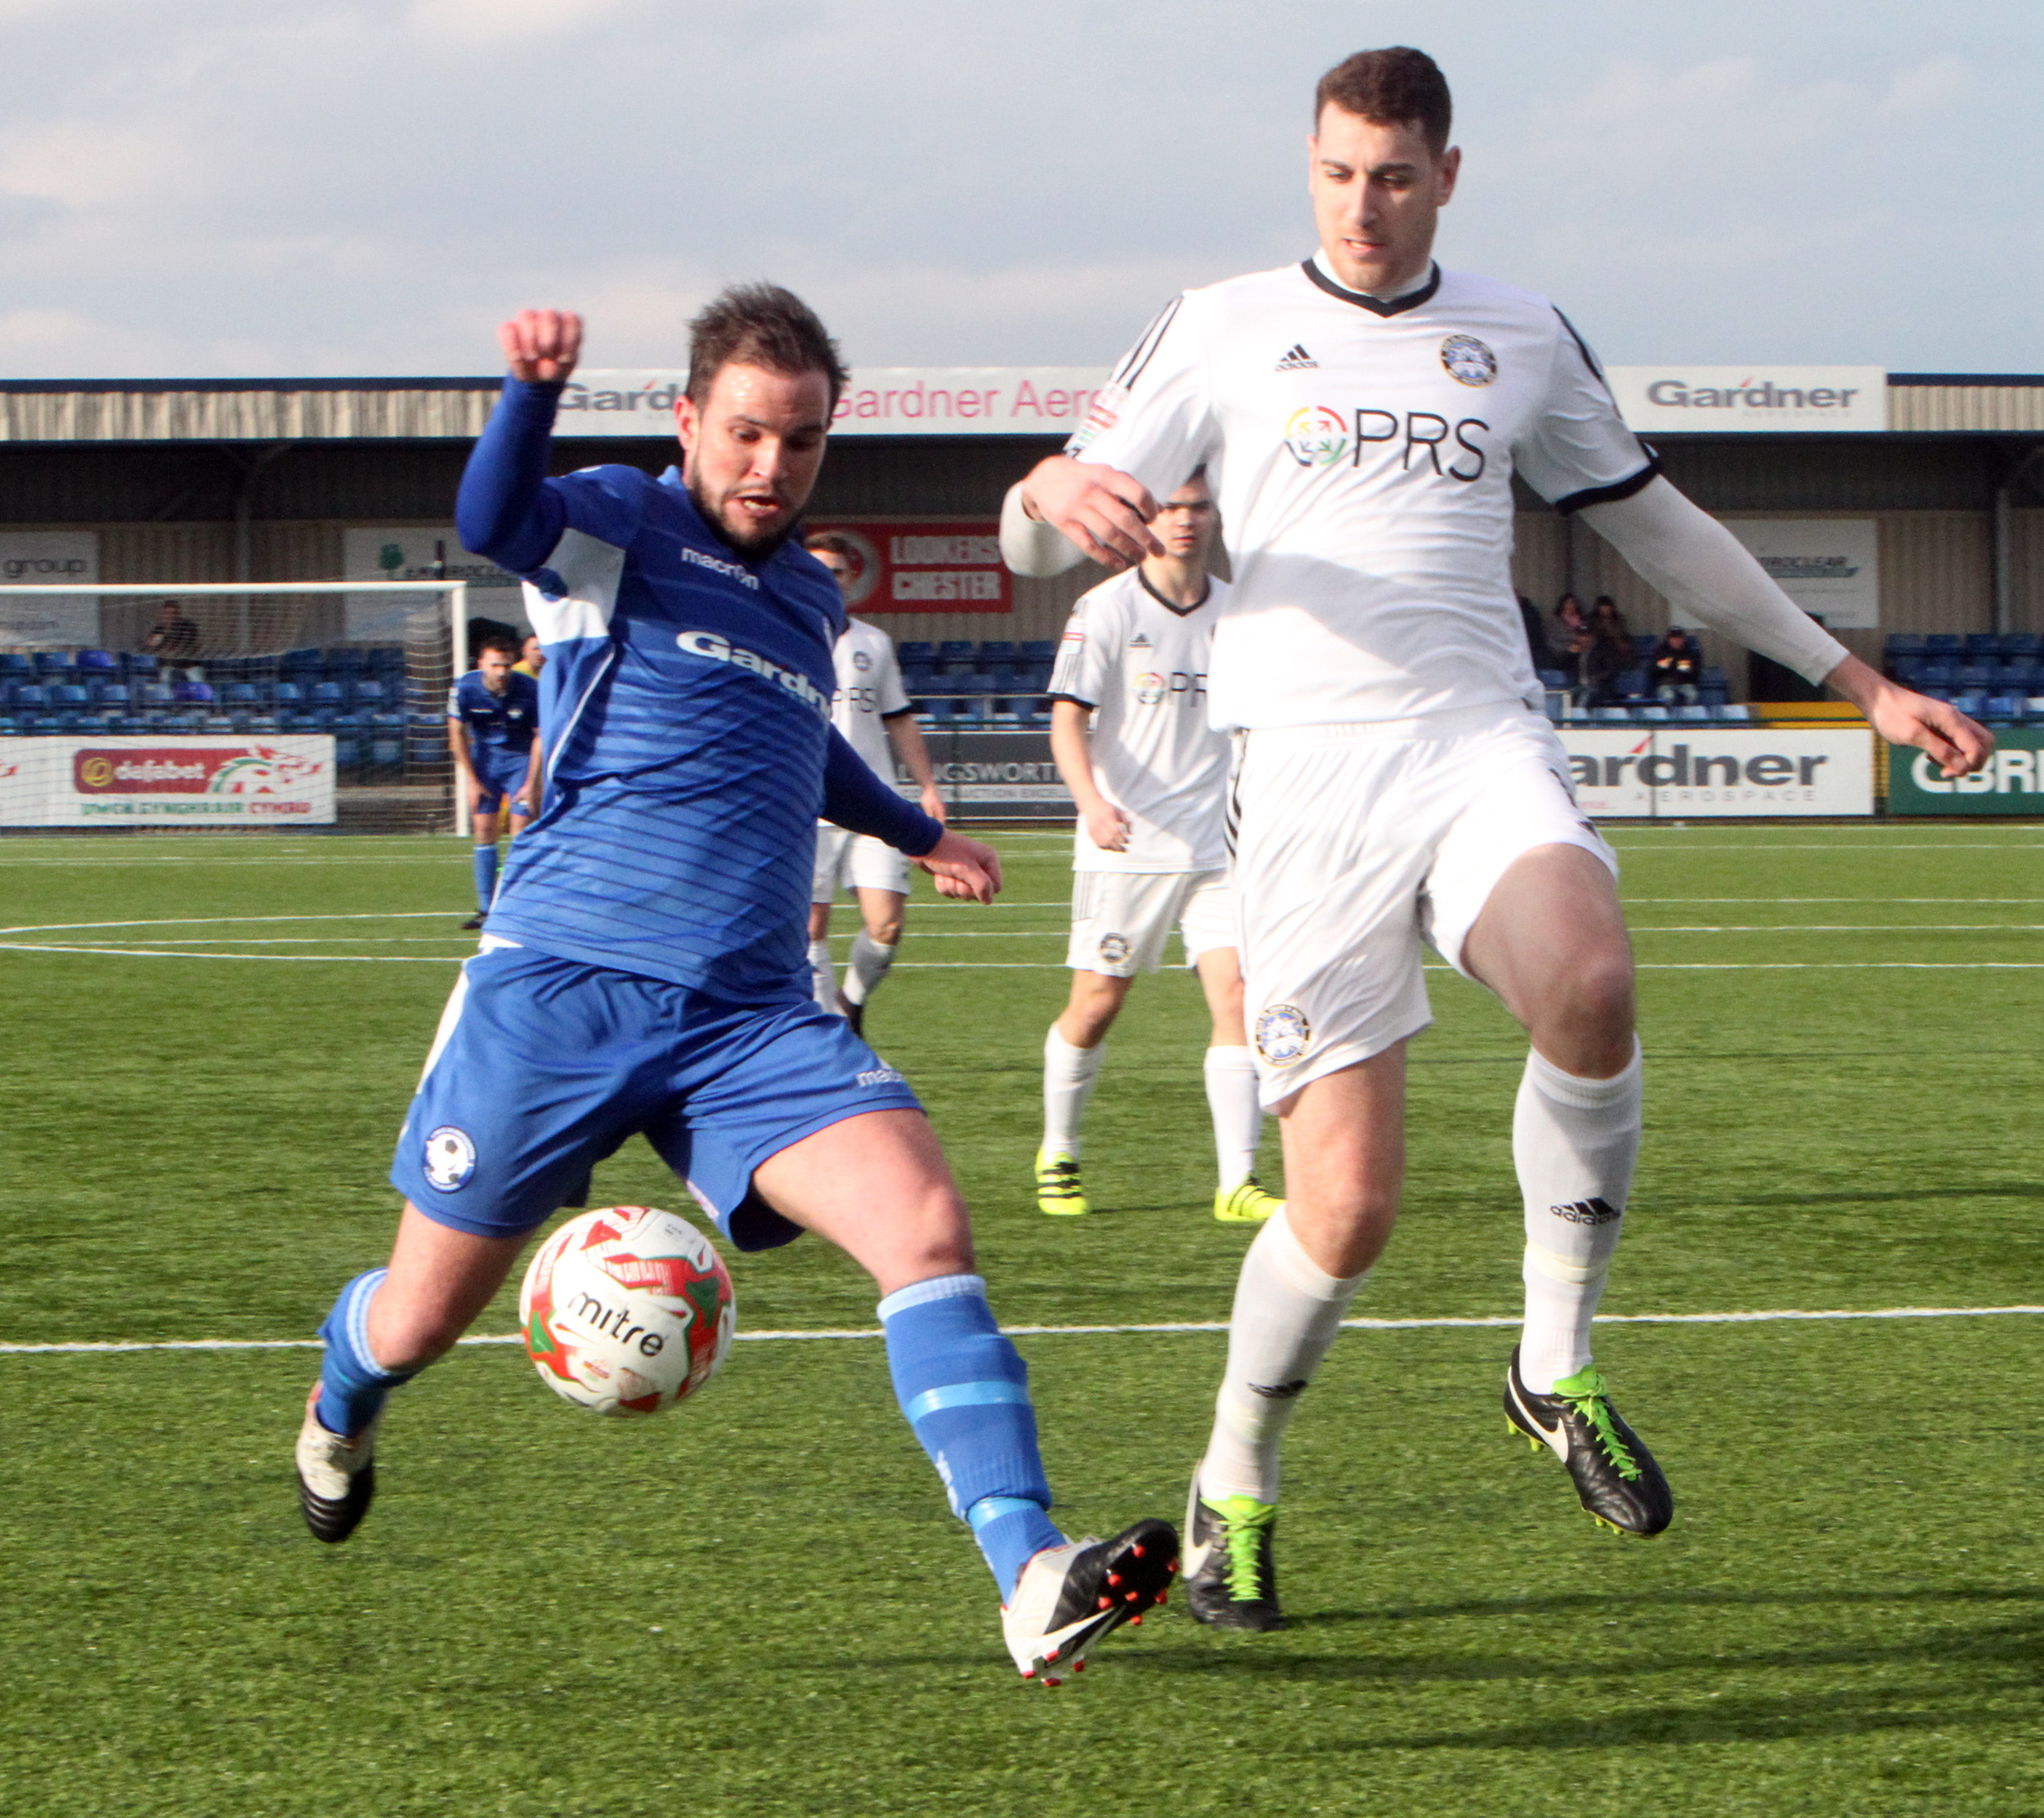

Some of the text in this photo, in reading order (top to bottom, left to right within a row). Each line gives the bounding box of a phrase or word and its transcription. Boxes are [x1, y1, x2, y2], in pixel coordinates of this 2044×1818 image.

[831, 379, 1000, 419] Gardner
[1647, 379, 1859, 409] Gardner
[1353, 408, 1490, 482] PRS
[2, 558, 87, 579] group
[681, 547, 760, 591] macron
[893, 571, 1001, 601] CHESTER
[1568, 743, 1829, 787] ardner
[1912, 749, 2044, 794] CBR
[1634, 789, 1818, 803] AEROSPACE
[568, 1291, 665, 1358] mitre
